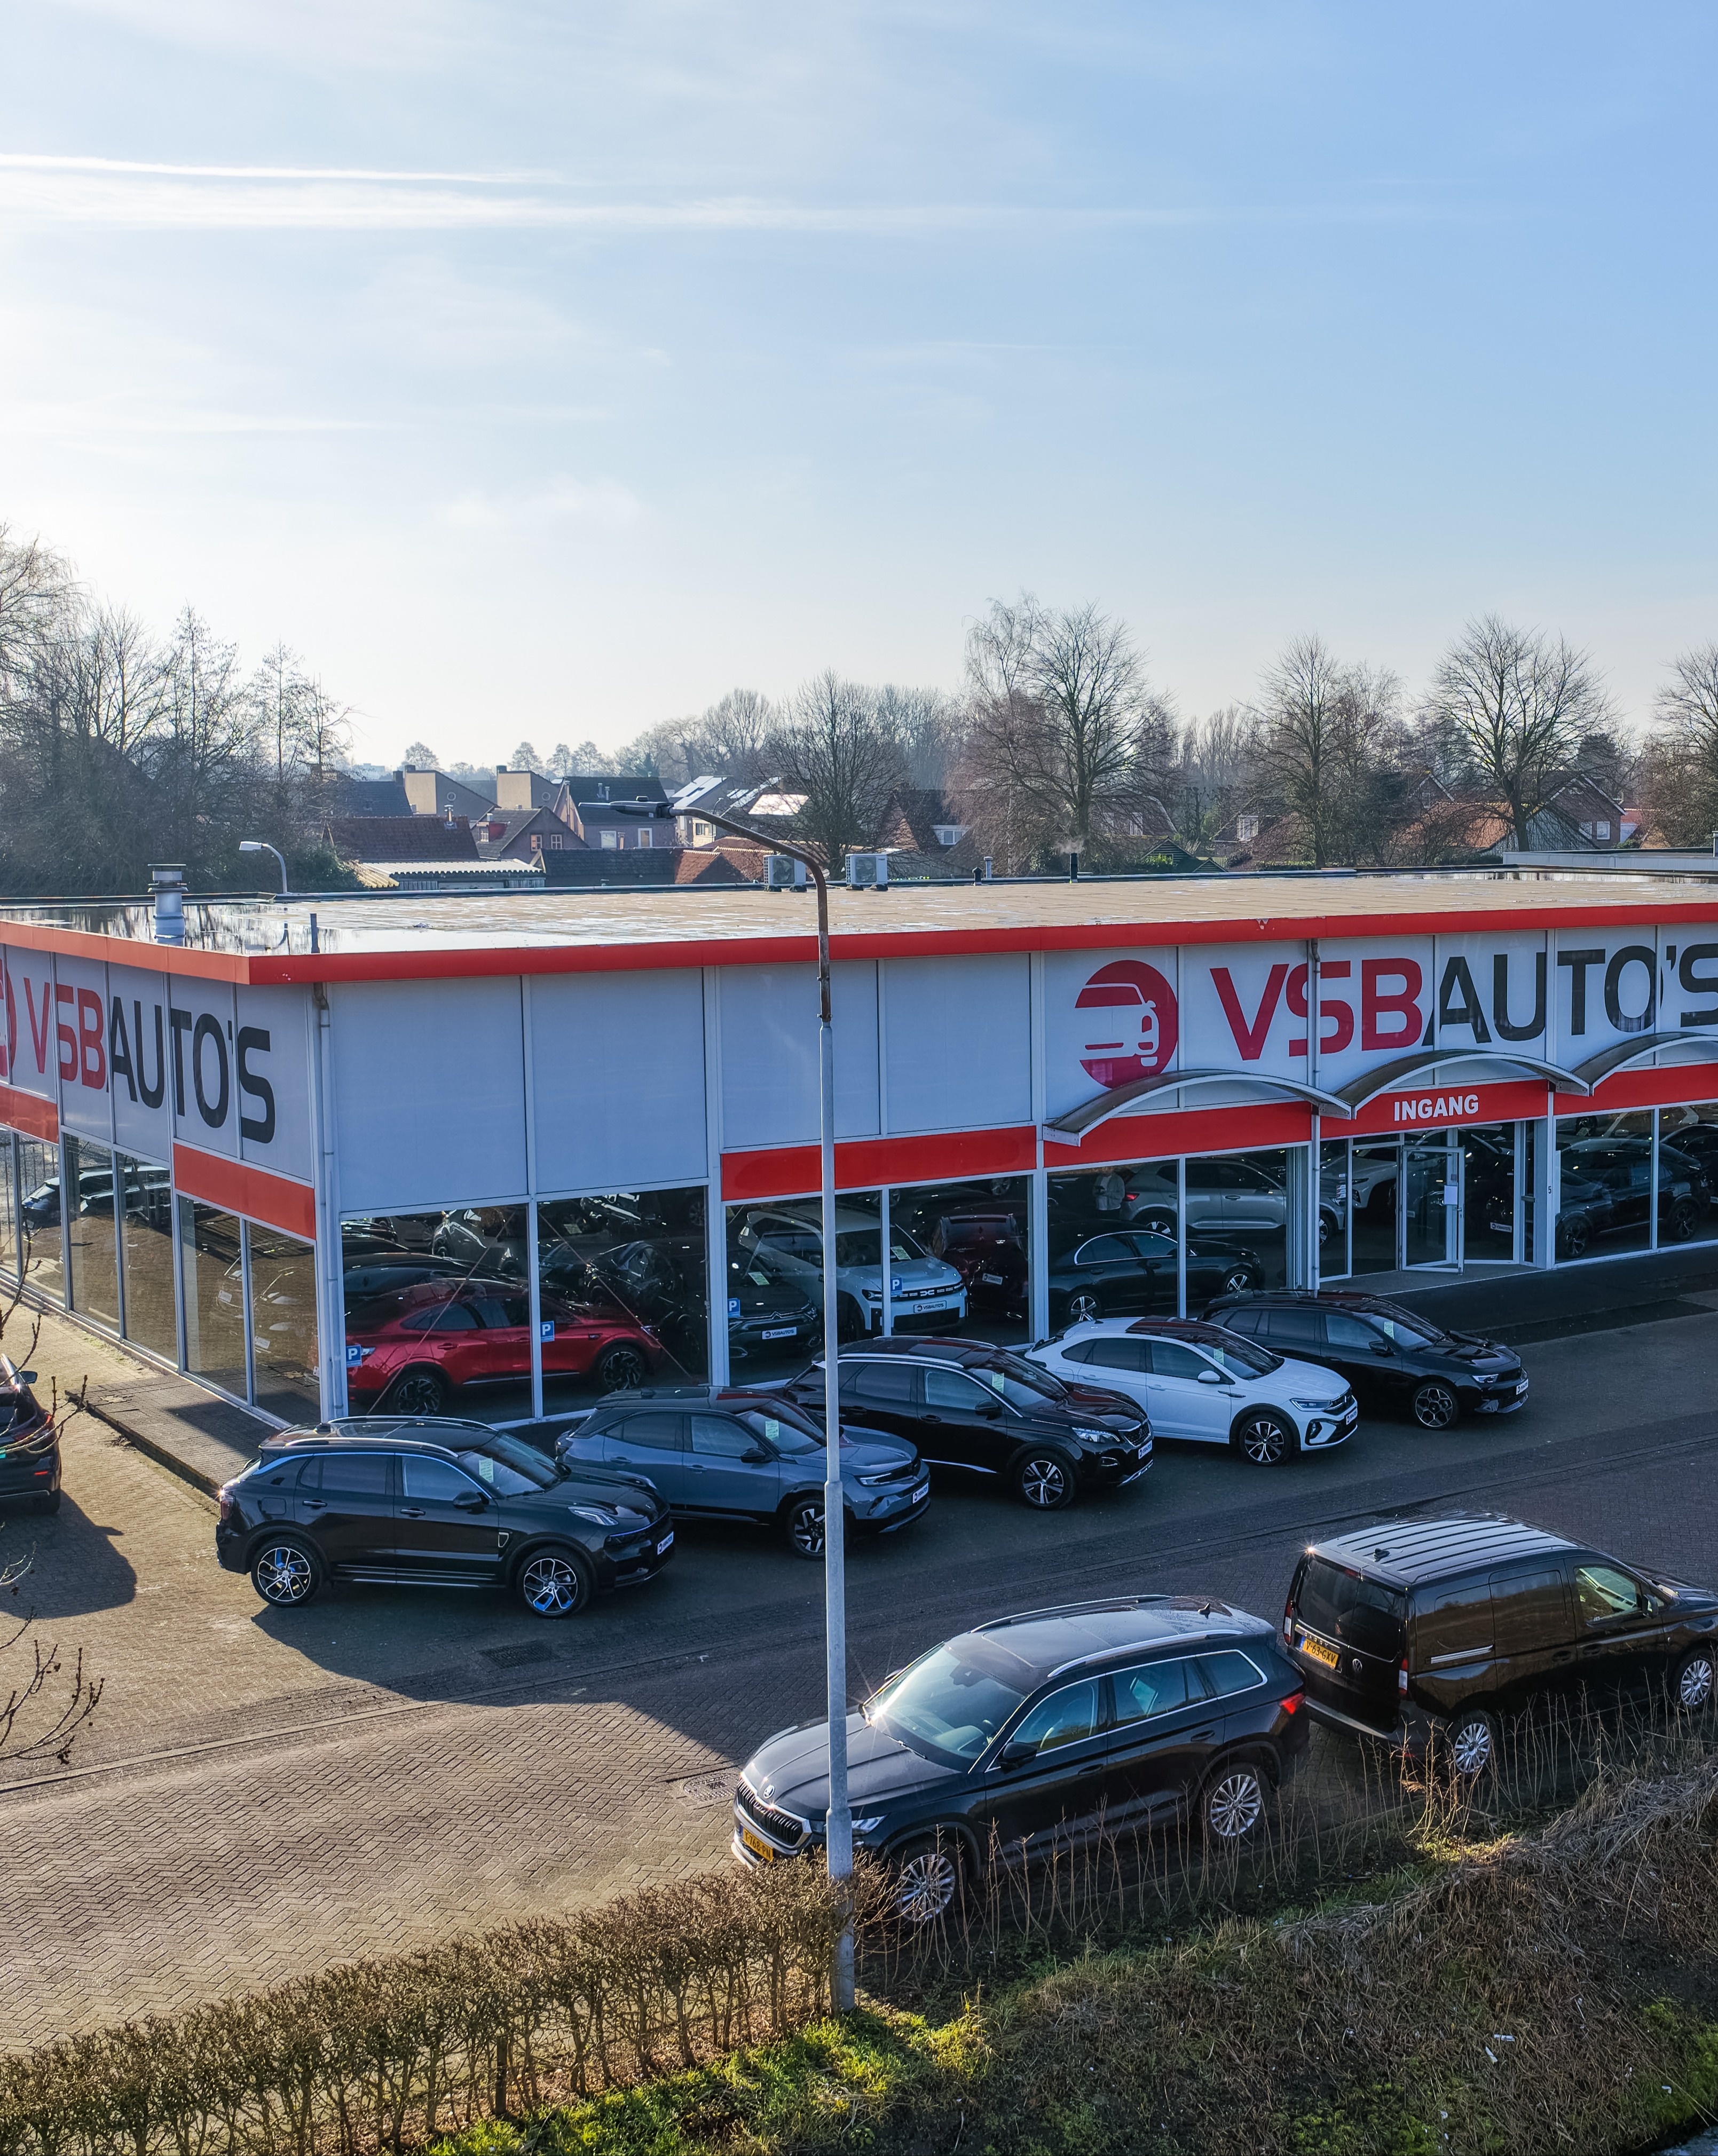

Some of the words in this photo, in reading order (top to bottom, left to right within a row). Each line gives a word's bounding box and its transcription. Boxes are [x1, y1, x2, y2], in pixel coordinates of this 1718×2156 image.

[1394, 1094, 1479, 1122] INGANG
[1548, 1186, 1551, 1194] 5
[892, 1279, 900, 1290] P
[729, 1300, 737, 1312] P
[542, 1324, 551, 1336] P
[348, 1348, 358, 1360] P
[1306, 1640, 1336, 1663] V-63-GXV
